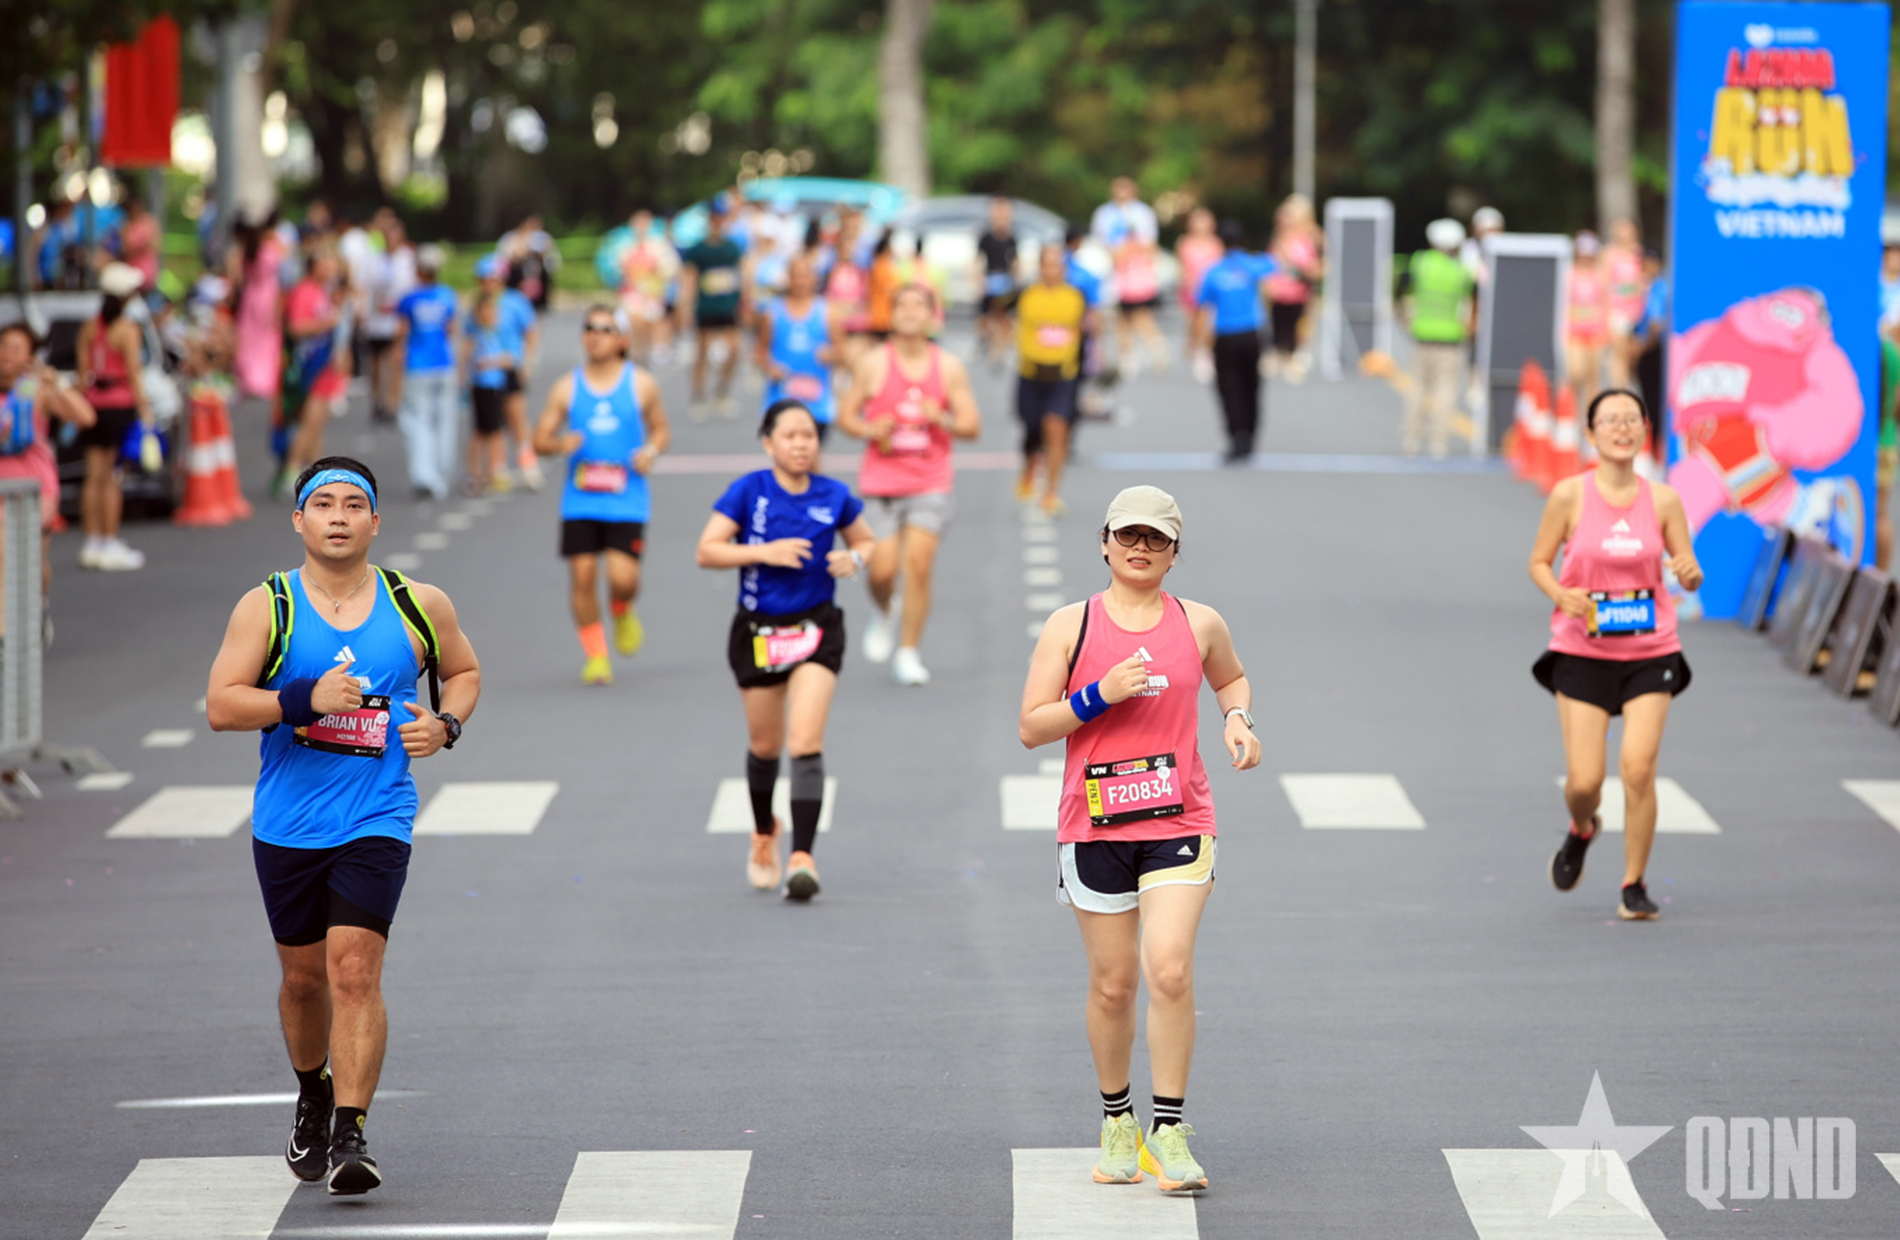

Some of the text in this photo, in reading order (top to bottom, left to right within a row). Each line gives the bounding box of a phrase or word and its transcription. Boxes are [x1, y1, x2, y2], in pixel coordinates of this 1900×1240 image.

[1711, 85, 1854, 178] RUN
[1714, 209, 1845, 238] VIETNAM
[318, 714, 376, 733] BRIAN VU
[1091, 766, 1107, 775] VN
[1088, 783, 1098, 798] PEN
[1107, 779, 1173, 805] F20834
